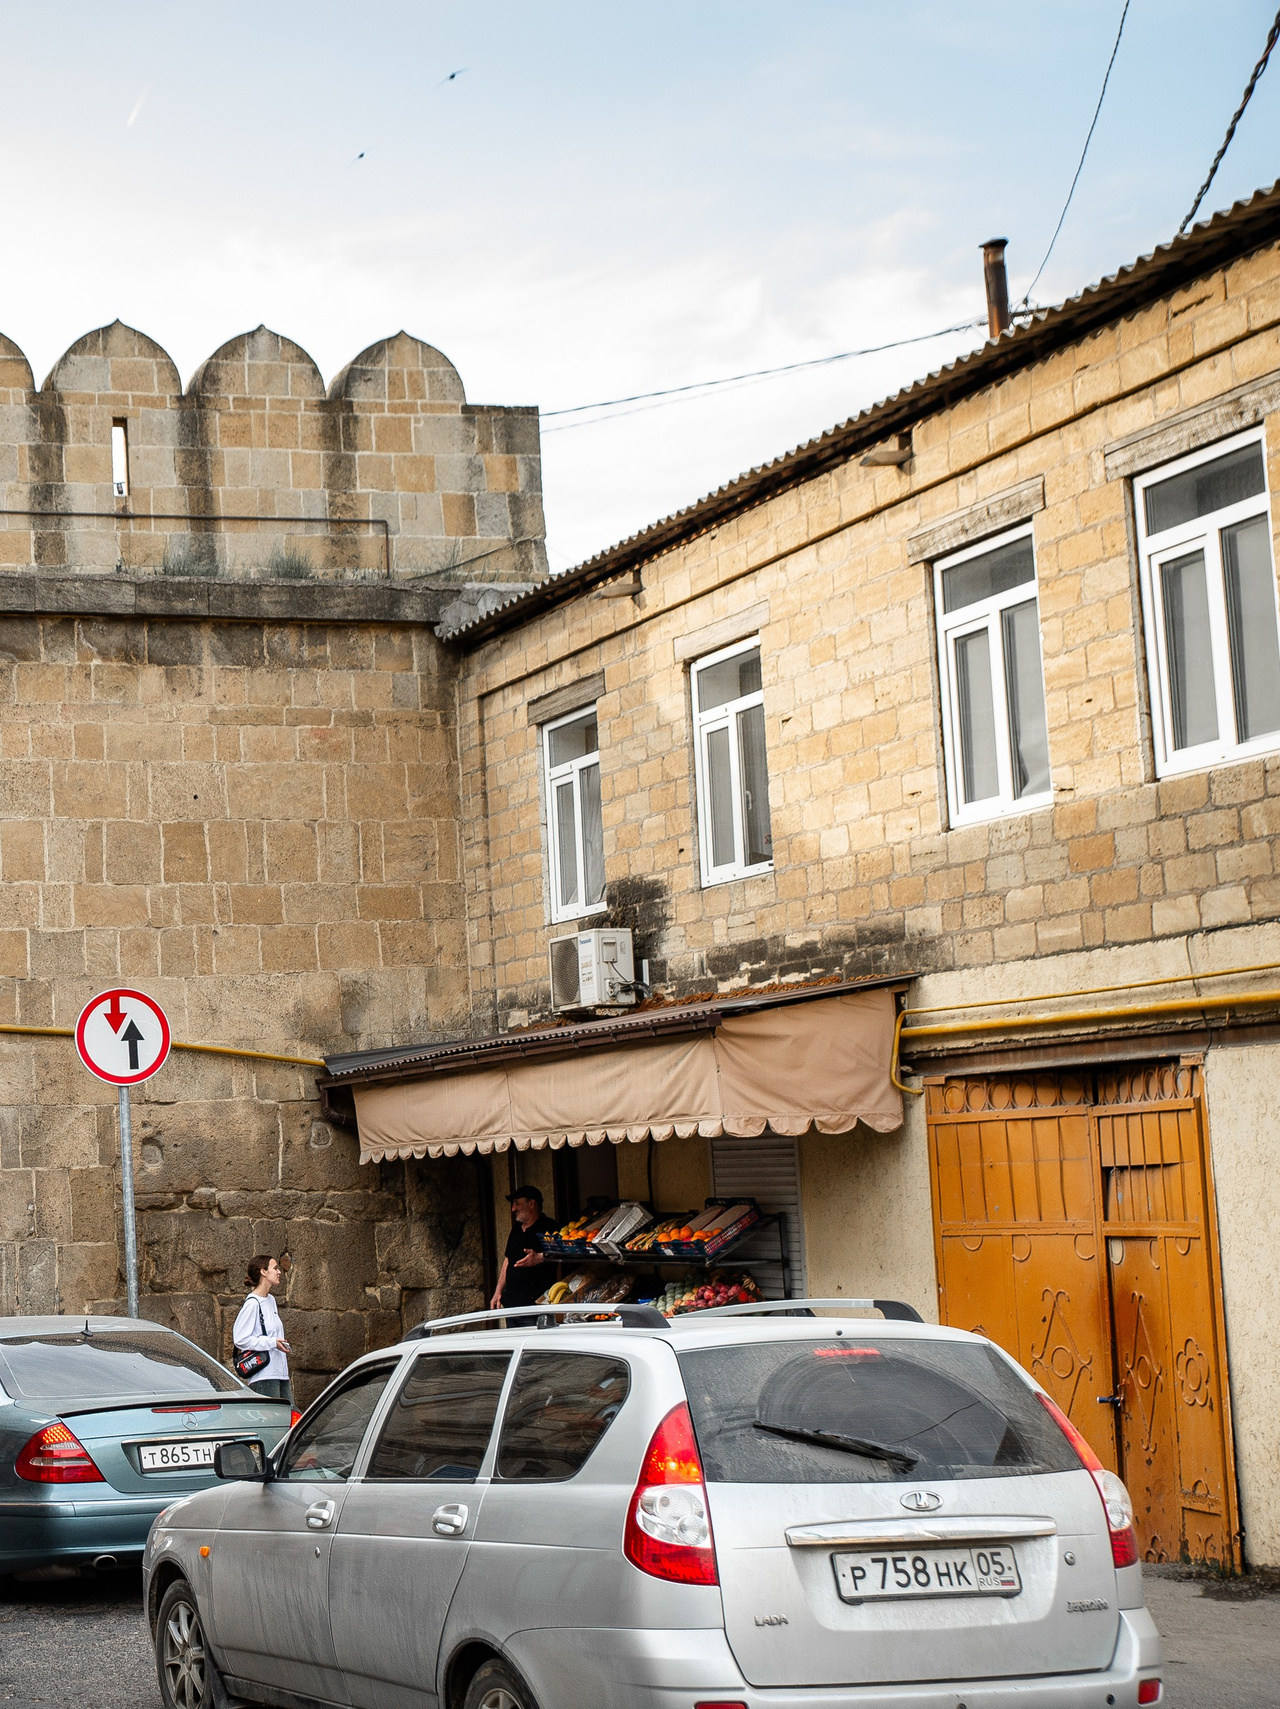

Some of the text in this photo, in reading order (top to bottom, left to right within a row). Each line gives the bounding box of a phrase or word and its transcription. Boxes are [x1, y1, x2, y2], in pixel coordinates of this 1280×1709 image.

[976, 1551, 1005, 1576] 05
[979, 1577, 1000, 1587] RUS
[754, 1613, 789, 1627] LADA
